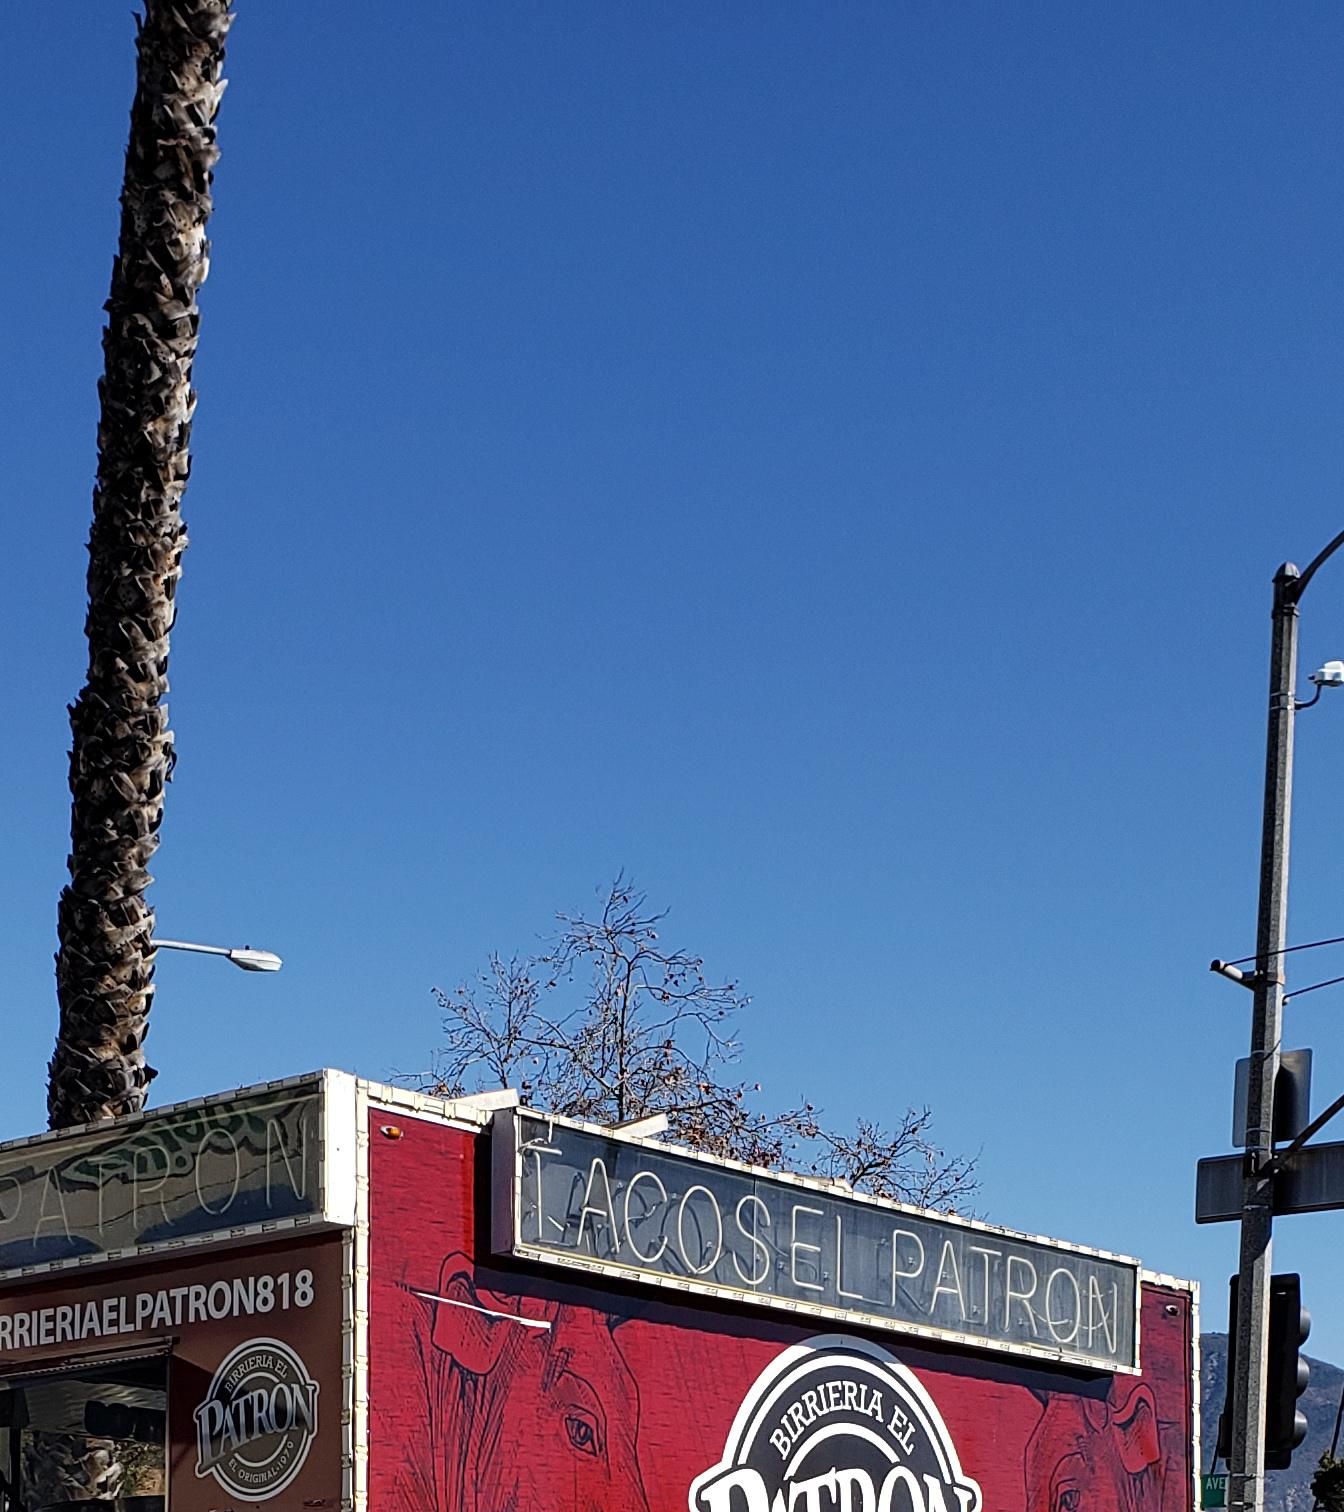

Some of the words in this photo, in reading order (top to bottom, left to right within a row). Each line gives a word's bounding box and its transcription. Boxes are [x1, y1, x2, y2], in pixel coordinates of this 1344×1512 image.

[891, 1228, 1119, 1354] PATRON
[224, 1354, 274, 1393] BIRRIERIA
[274, 1361, 288, 1379] EL
[198, 1382, 315, 1471] PATRON
[769, 1380, 885, 1460] BIRRIERIA
[887, 1405, 916, 1455] EL
[228, 1459, 237, 1473] EL
[1205, 1476, 1225, 1490] AVE
